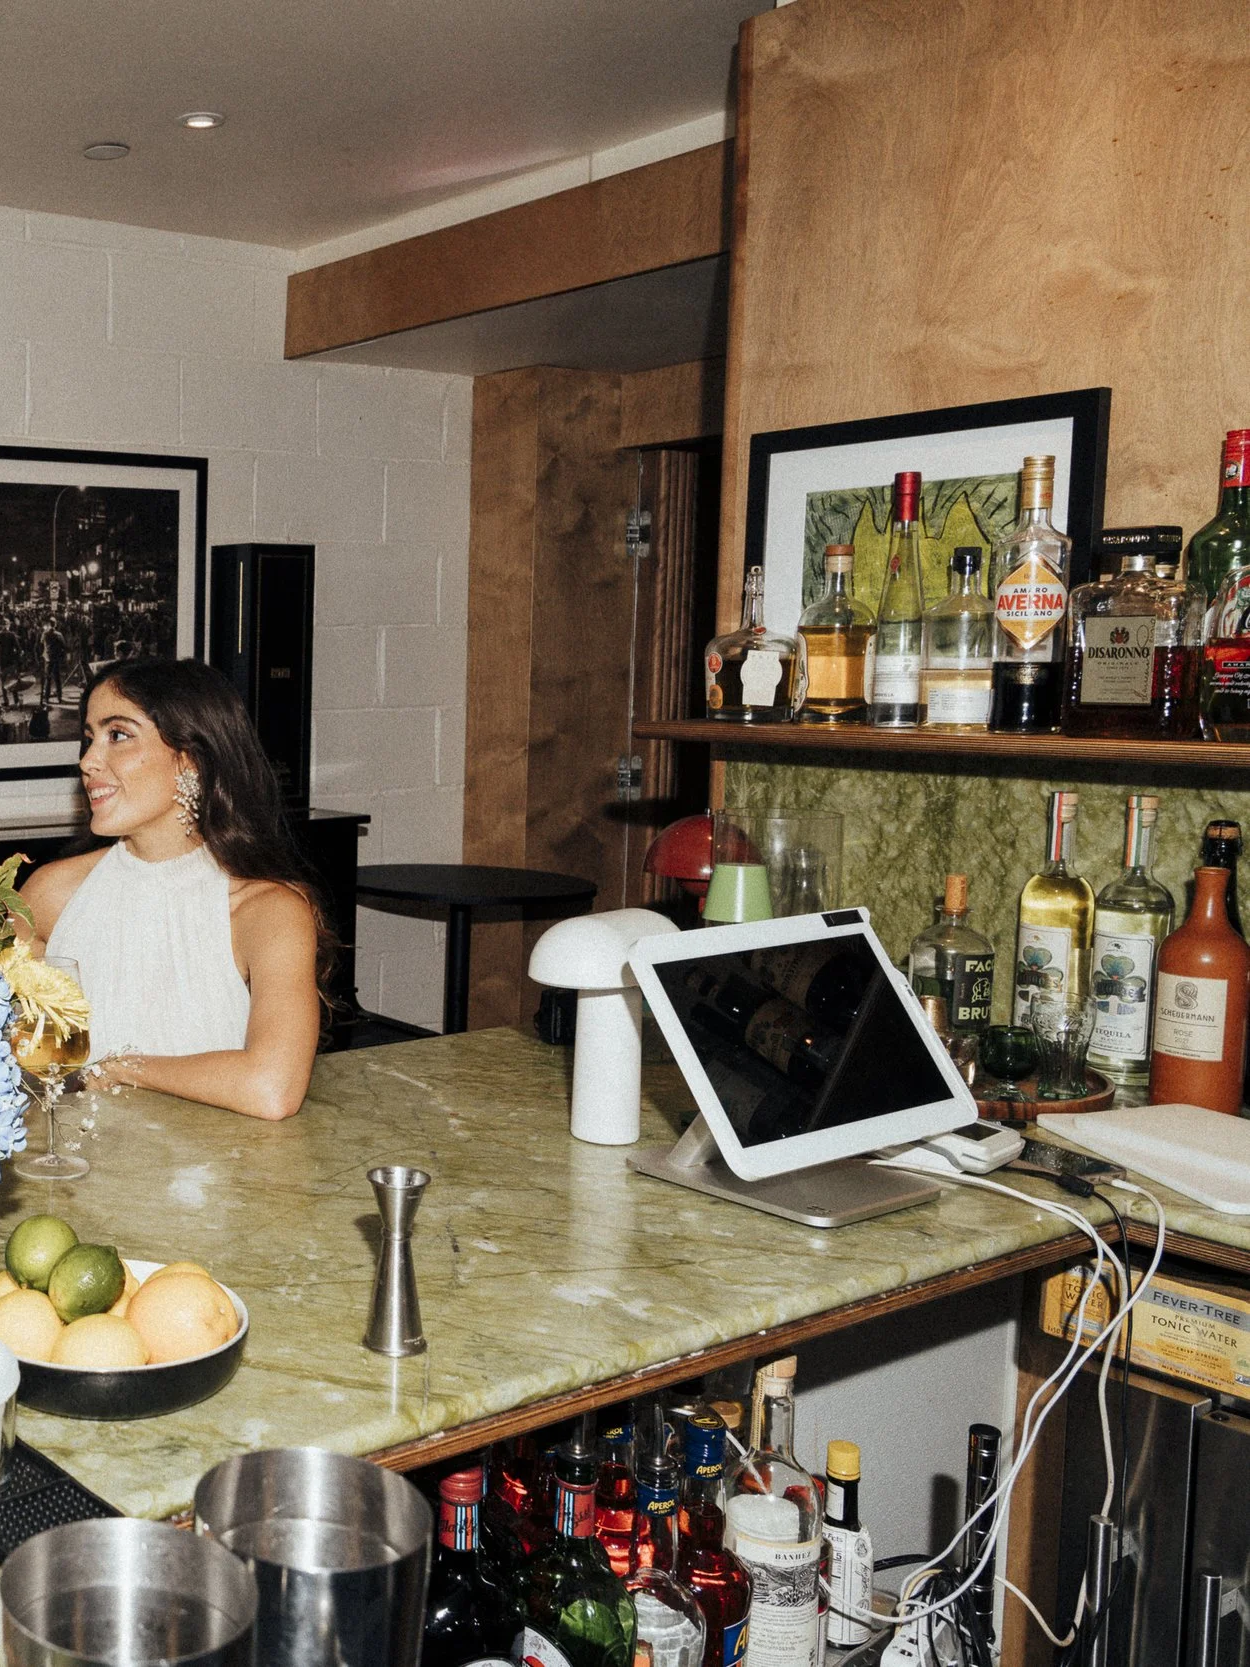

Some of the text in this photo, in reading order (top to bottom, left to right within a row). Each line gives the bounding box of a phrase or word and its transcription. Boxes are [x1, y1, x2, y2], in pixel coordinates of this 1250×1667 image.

[997, 593, 1064, 610] AVERNA
[1087, 646, 1150, 659] DISARONNO
[964, 960, 995, 973] FAC
[958, 1006, 990, 1020] BRU
[1095, 1027, 1131, 1039] TEQUILA
[1067, 1283, 1102, 1299] TOIC
[1065, 1291, 1103, 1309] WER
[1153, 1291, 1240, 1325] FEVER-TREE
[1174, 1314, 1216, 1330] PREMIUM
[1151, 1315, 1191, 1334] TONIC
[1195, 1327, 1238, 1349] WATER
[696, 1463, 723, 1475] APEROL
[647, 1499, 675, 1511] APEROL
[774, 1551, 812, 1561] BANHEZ
